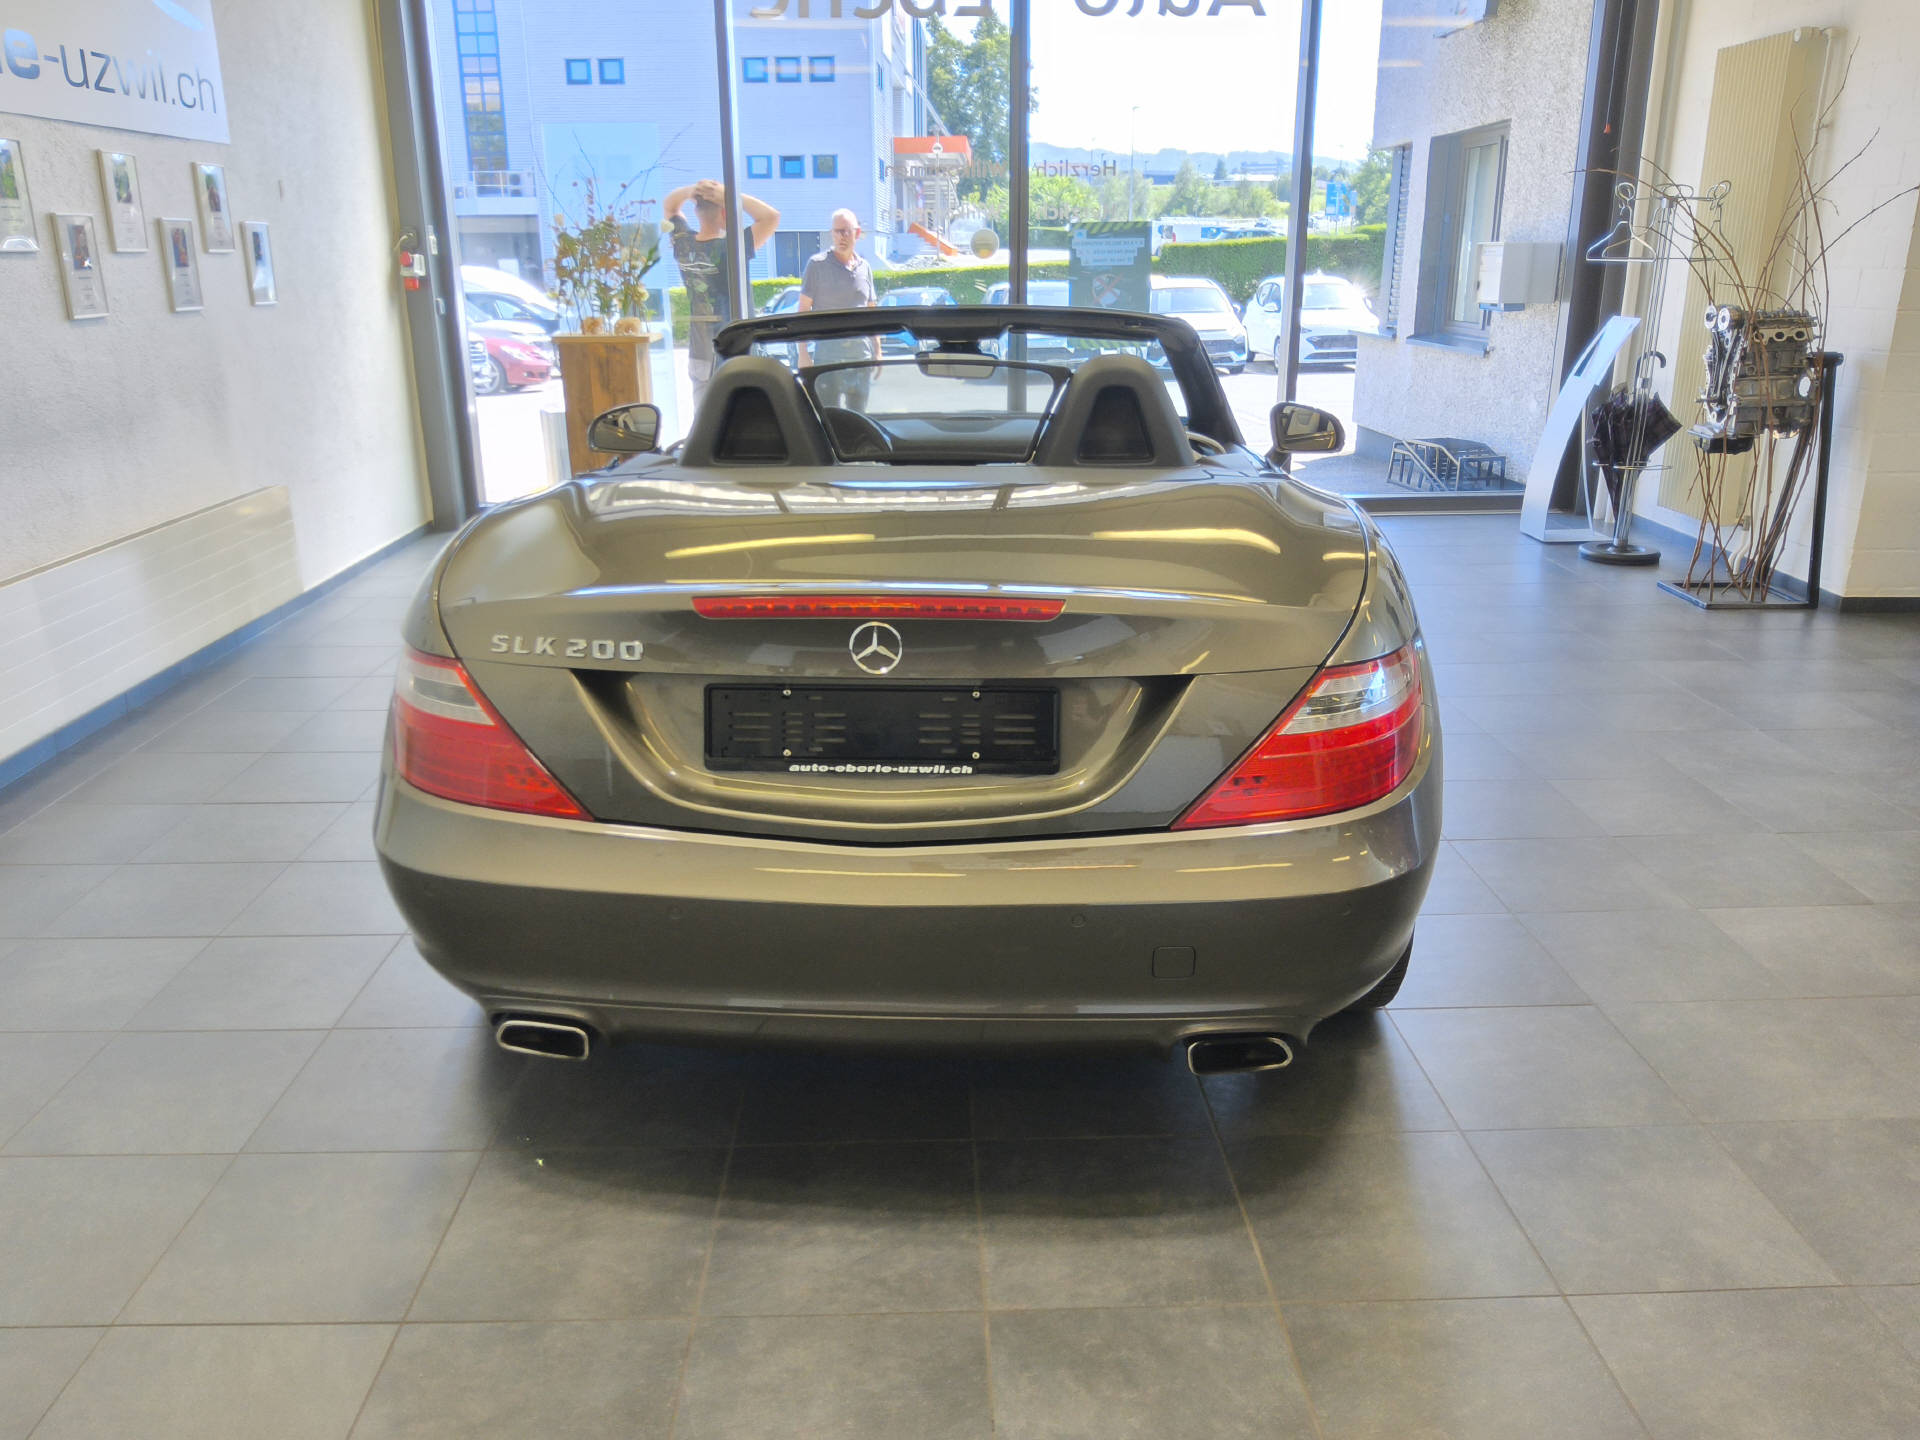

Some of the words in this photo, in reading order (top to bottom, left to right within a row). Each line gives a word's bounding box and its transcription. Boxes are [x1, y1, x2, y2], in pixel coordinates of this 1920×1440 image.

[0, 27, 217, 114] e-uzwil.ch
[490, 634, 559, 656] SLK
[565, 638, 644, 661] 200
